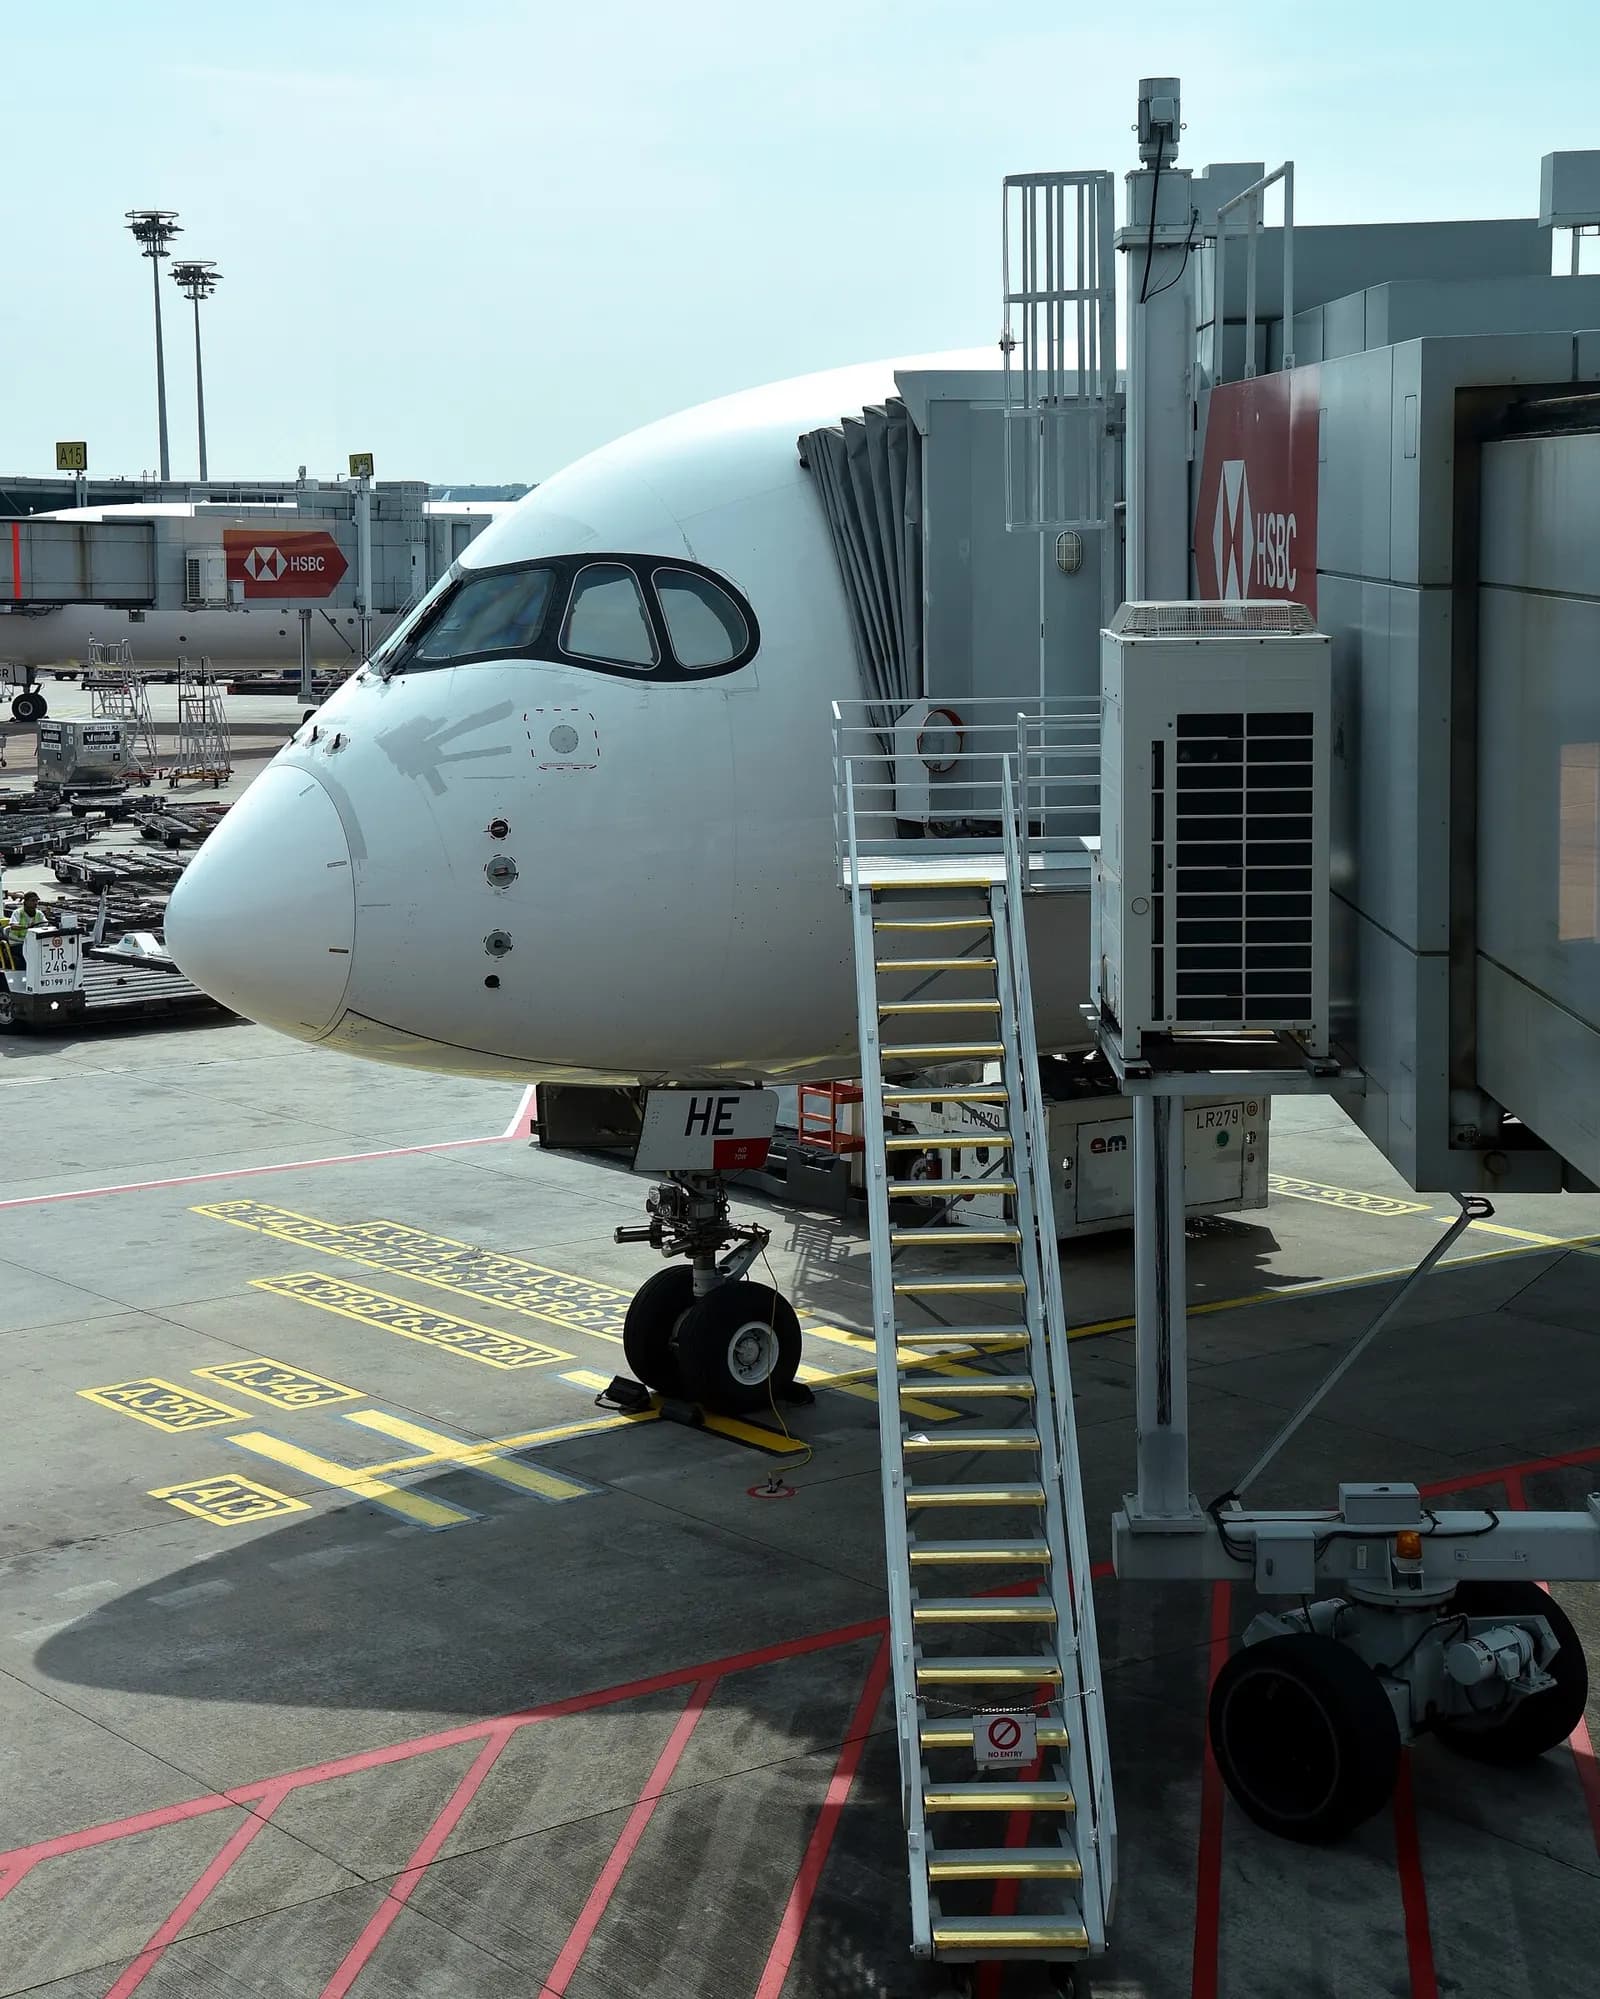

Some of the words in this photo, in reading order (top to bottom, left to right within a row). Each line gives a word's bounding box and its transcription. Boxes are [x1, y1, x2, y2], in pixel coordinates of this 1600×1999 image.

[60, 447, 82, 465] A15
[1257, 512, 1297, 592] HSBC
[290, 556, 325, 572] HSBC
[0, 668, 9, 678] R
[49, 948, 65, 960] TR
[45, 960, 67, 973] 246
[684, 1096, 740, 1136] HE
[1196, 1109, 1239, 1130] LR279
[214, 1366, 337, 1403] A346
[102, 1387, 225, 1425] A35K
[175, 1486, 278, 1517] A13
